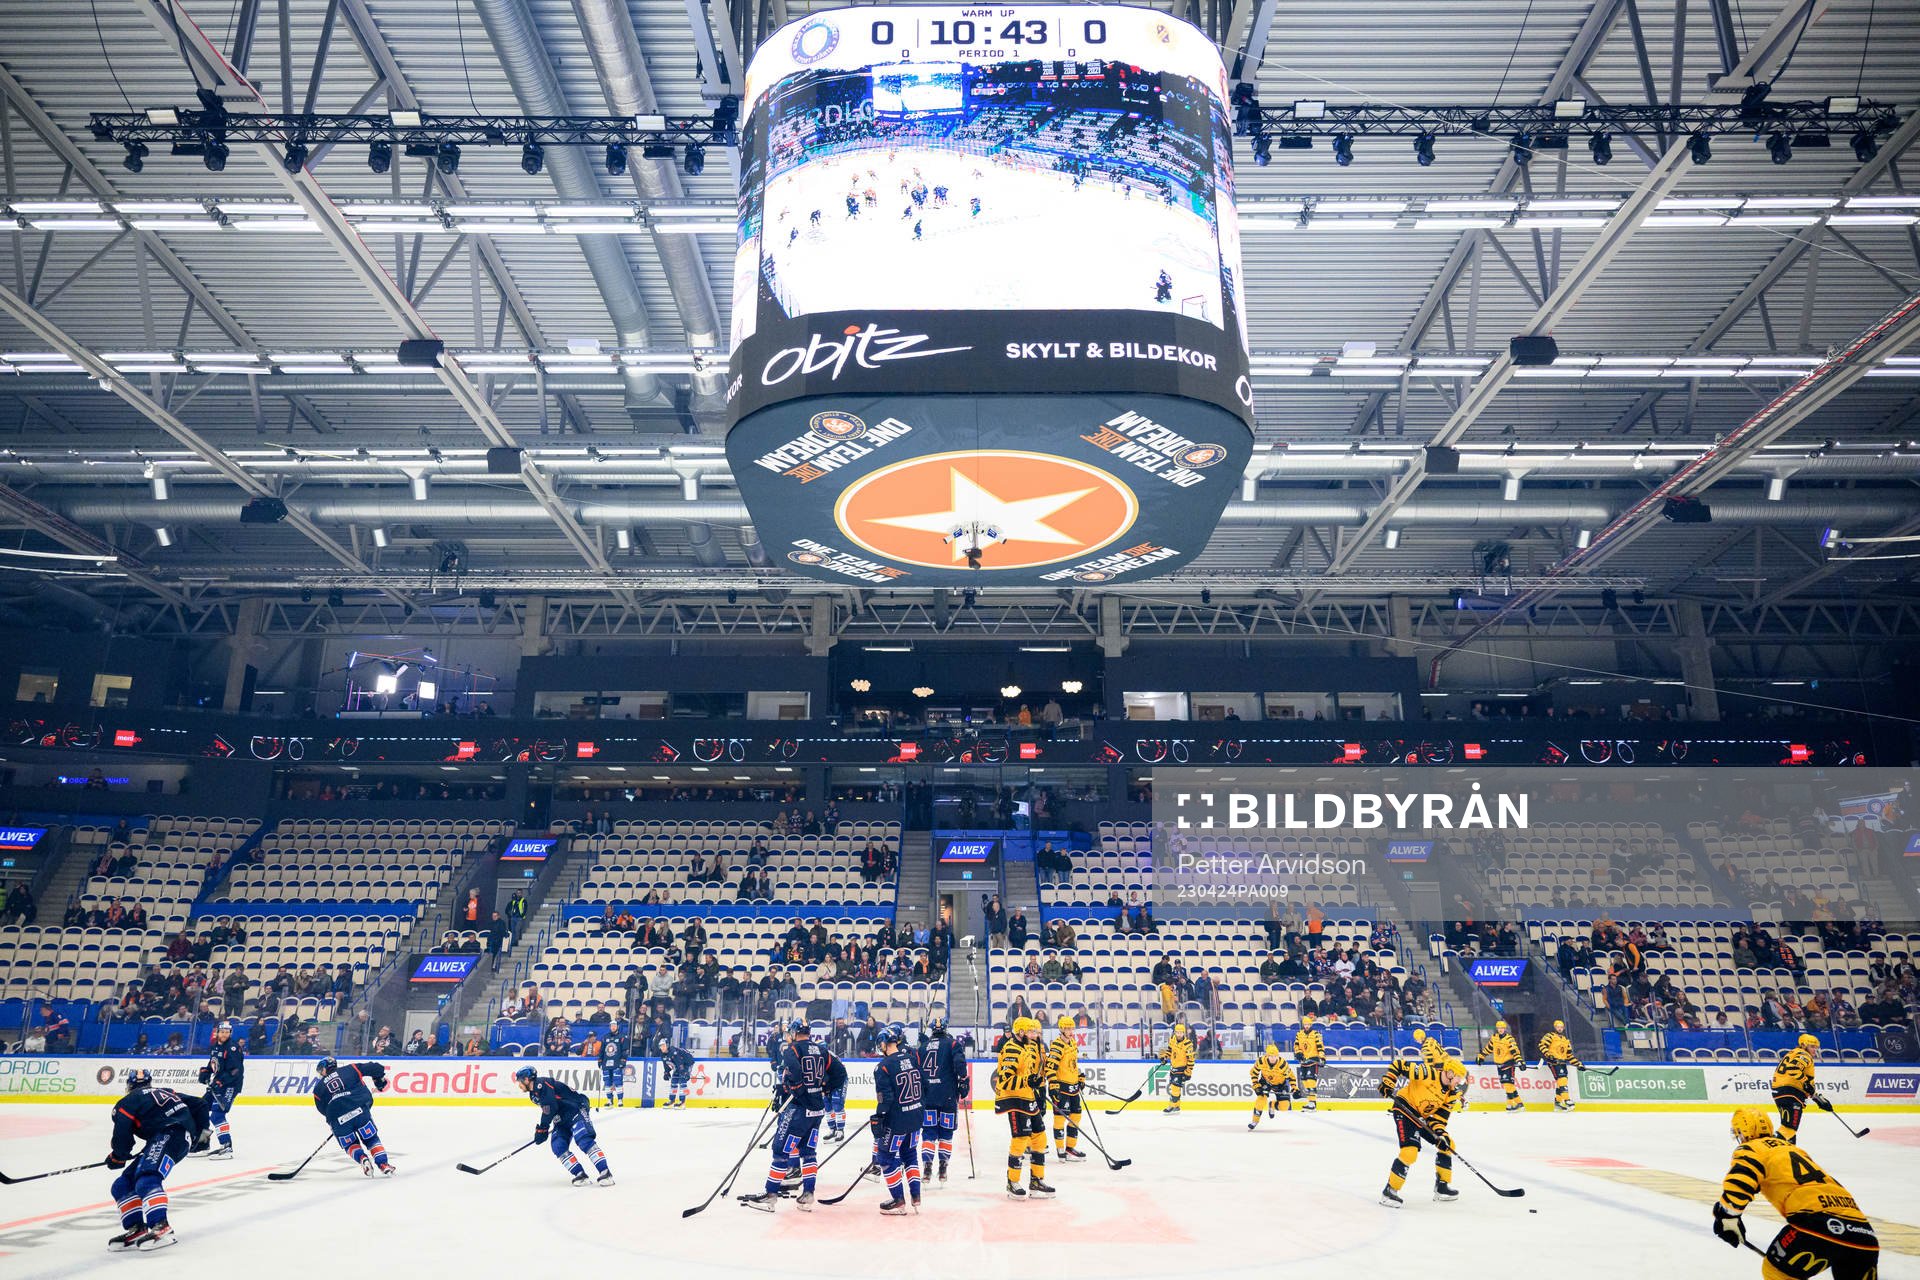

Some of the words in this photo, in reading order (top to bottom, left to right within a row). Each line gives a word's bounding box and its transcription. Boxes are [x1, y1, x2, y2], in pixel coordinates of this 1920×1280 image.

[872, 21, 894, 45] 0
[930, 20, 1047, 45] 10:43
[1084, 20, 1106, 44] 0
[959, 49, 1005, 57] PERIOD
[1006, 342, 1080, 359] SKYLT
[1086, 342, 1103, 358] &
[1110, 342, 1217, 372] BILDEKOR
[1105, 409, 1196, 458] DREAM
[753, 430, 840, 473] DREAM
[809, 441, 874, 473] TEAM
[1109, 441, 1172, 473] TEAM
[832, 552, 886, 571] TEAM
[1075, 552, 1132, 573] TEAM
[1099, 547, 1181, 575] DREAM
[818, 560, 894, 583] DREAM
[0, 831, 37, 842] LWEX
[511, 843, 548, 853] ALWEX
[950, 845, 986, 855] ALWEX
[1390, 846, 1427, 856] ALWEX
[423, 961, 467, 973] ALWEX
[1474, 965, 1518, 976] ALWEX
[167, 1069, 189, 1077] STORA
[923, 1050, 939, 1077] 4
[267, 1076, 320, 1094] KPM
[549, 1069, 603, 1091] VISM
[716, 1071, 777, 1088] MIDCO
[896, 1069, 922, 1104] 26
[1350, 1078, 1379, 1087] WAP
[1589, 1082, 1606, 1092] ON
[1615, 1078, 1686, 1092] pacson.se
[1874, 1078, 1915, 1089] ALWEX
[1789, 1151, 1831, 1186] 4
